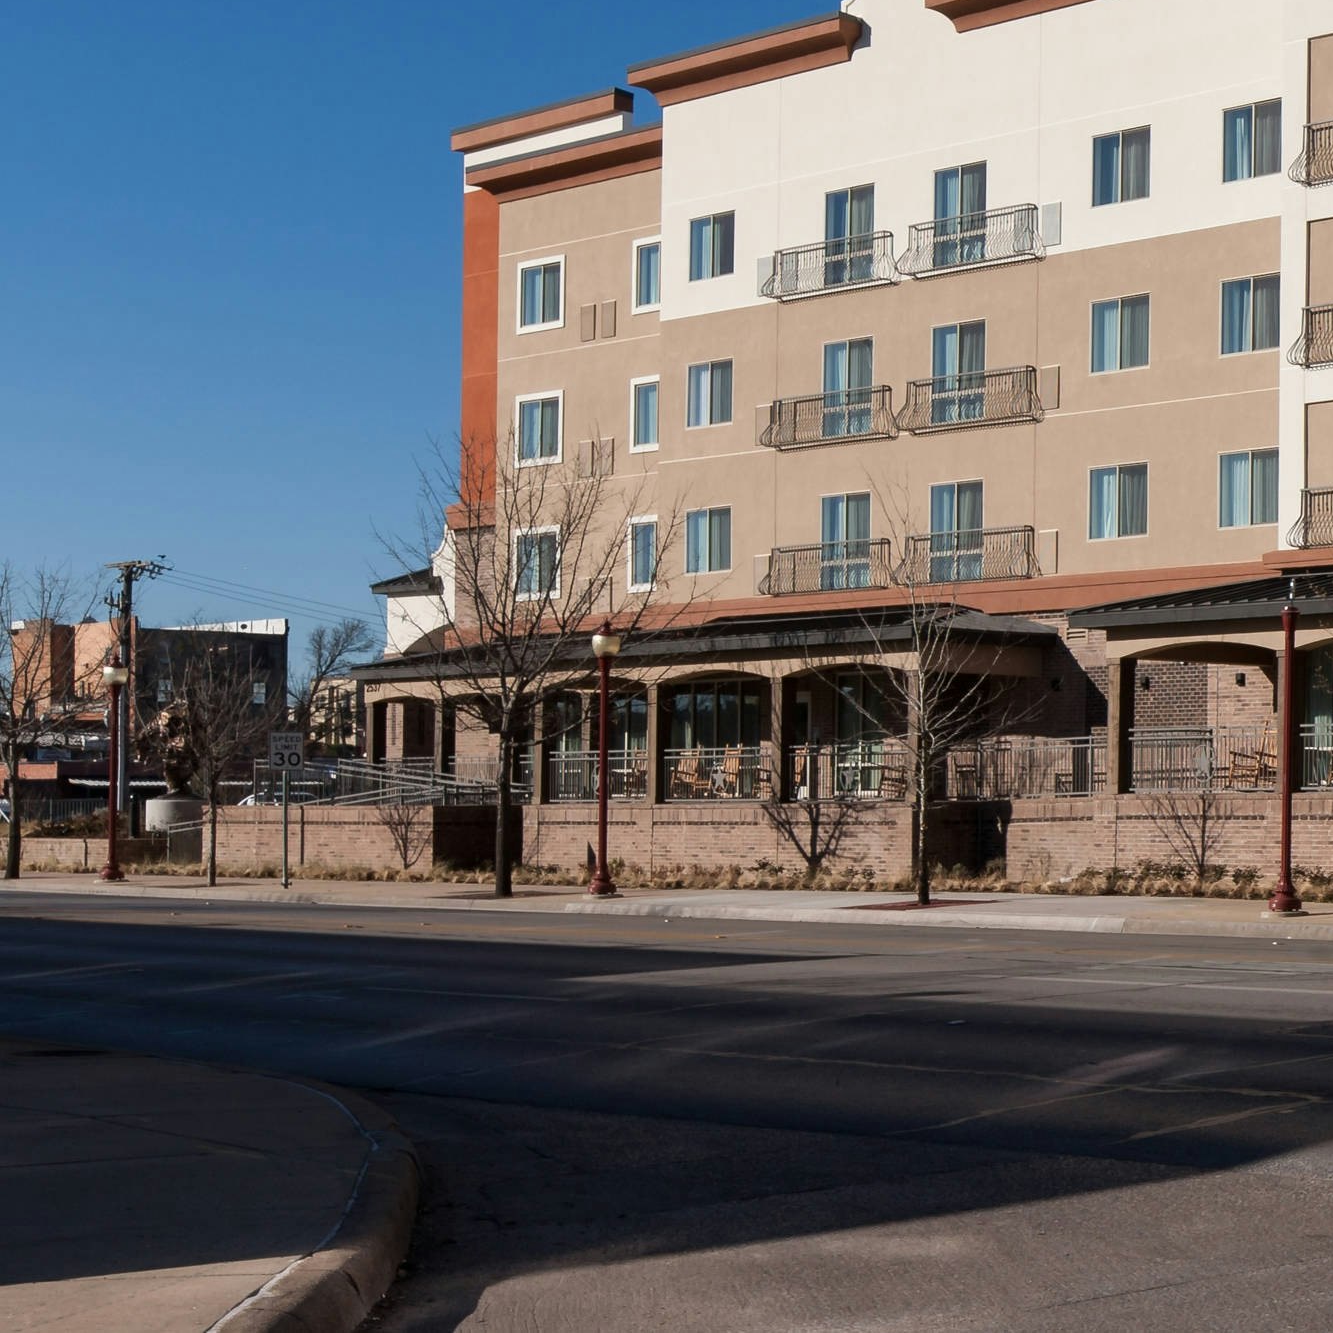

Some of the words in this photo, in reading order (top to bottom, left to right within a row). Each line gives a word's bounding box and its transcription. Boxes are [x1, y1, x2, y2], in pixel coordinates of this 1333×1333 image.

[272, 735, 301, 743] SPEED
[275, 743, 298, 751] LIMIT
[273, 751, 301, 767] 30
